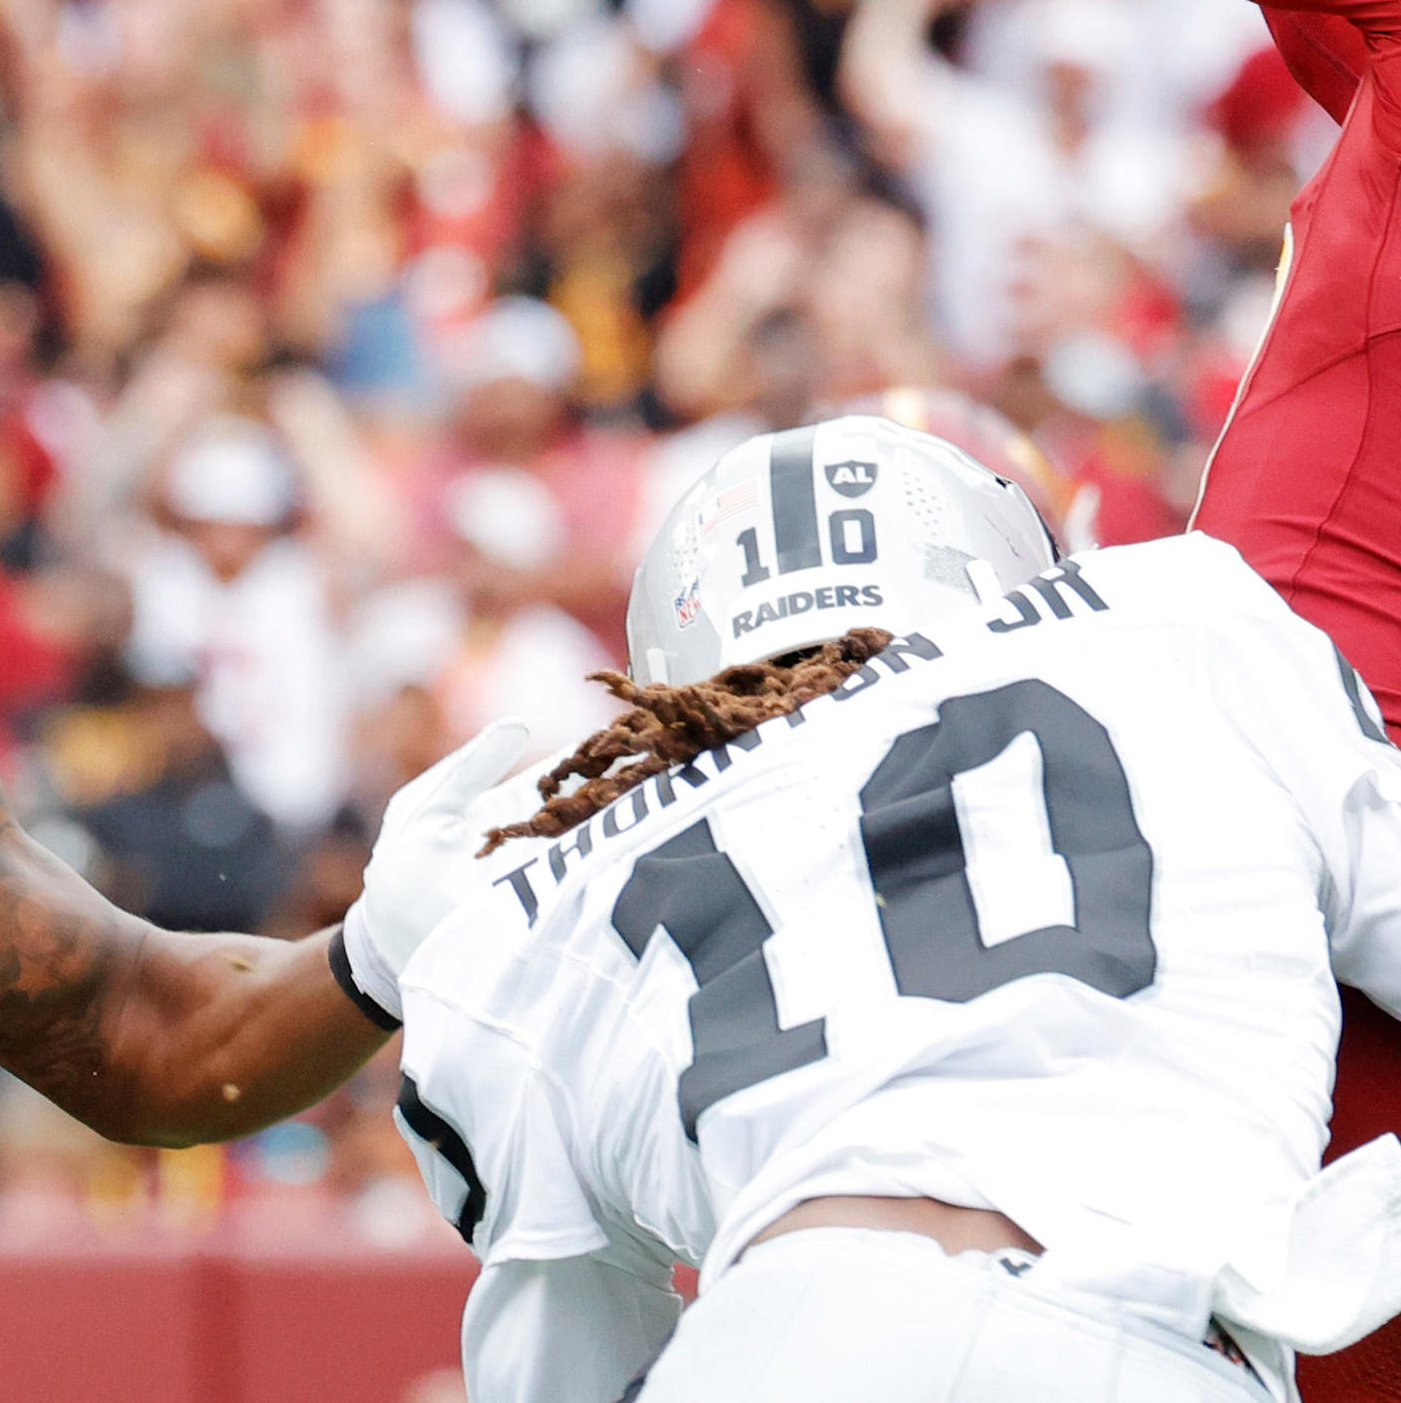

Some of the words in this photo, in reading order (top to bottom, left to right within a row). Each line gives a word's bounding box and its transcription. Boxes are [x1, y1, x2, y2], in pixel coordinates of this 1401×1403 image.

[832, 466, 873, 485] AL
[736, 508, 878, 588] 10
[732, 584, 884, 640] RAIDERS
[986, 558, 1110, 633] JR
[610, 679, 1157, 1143] 10
